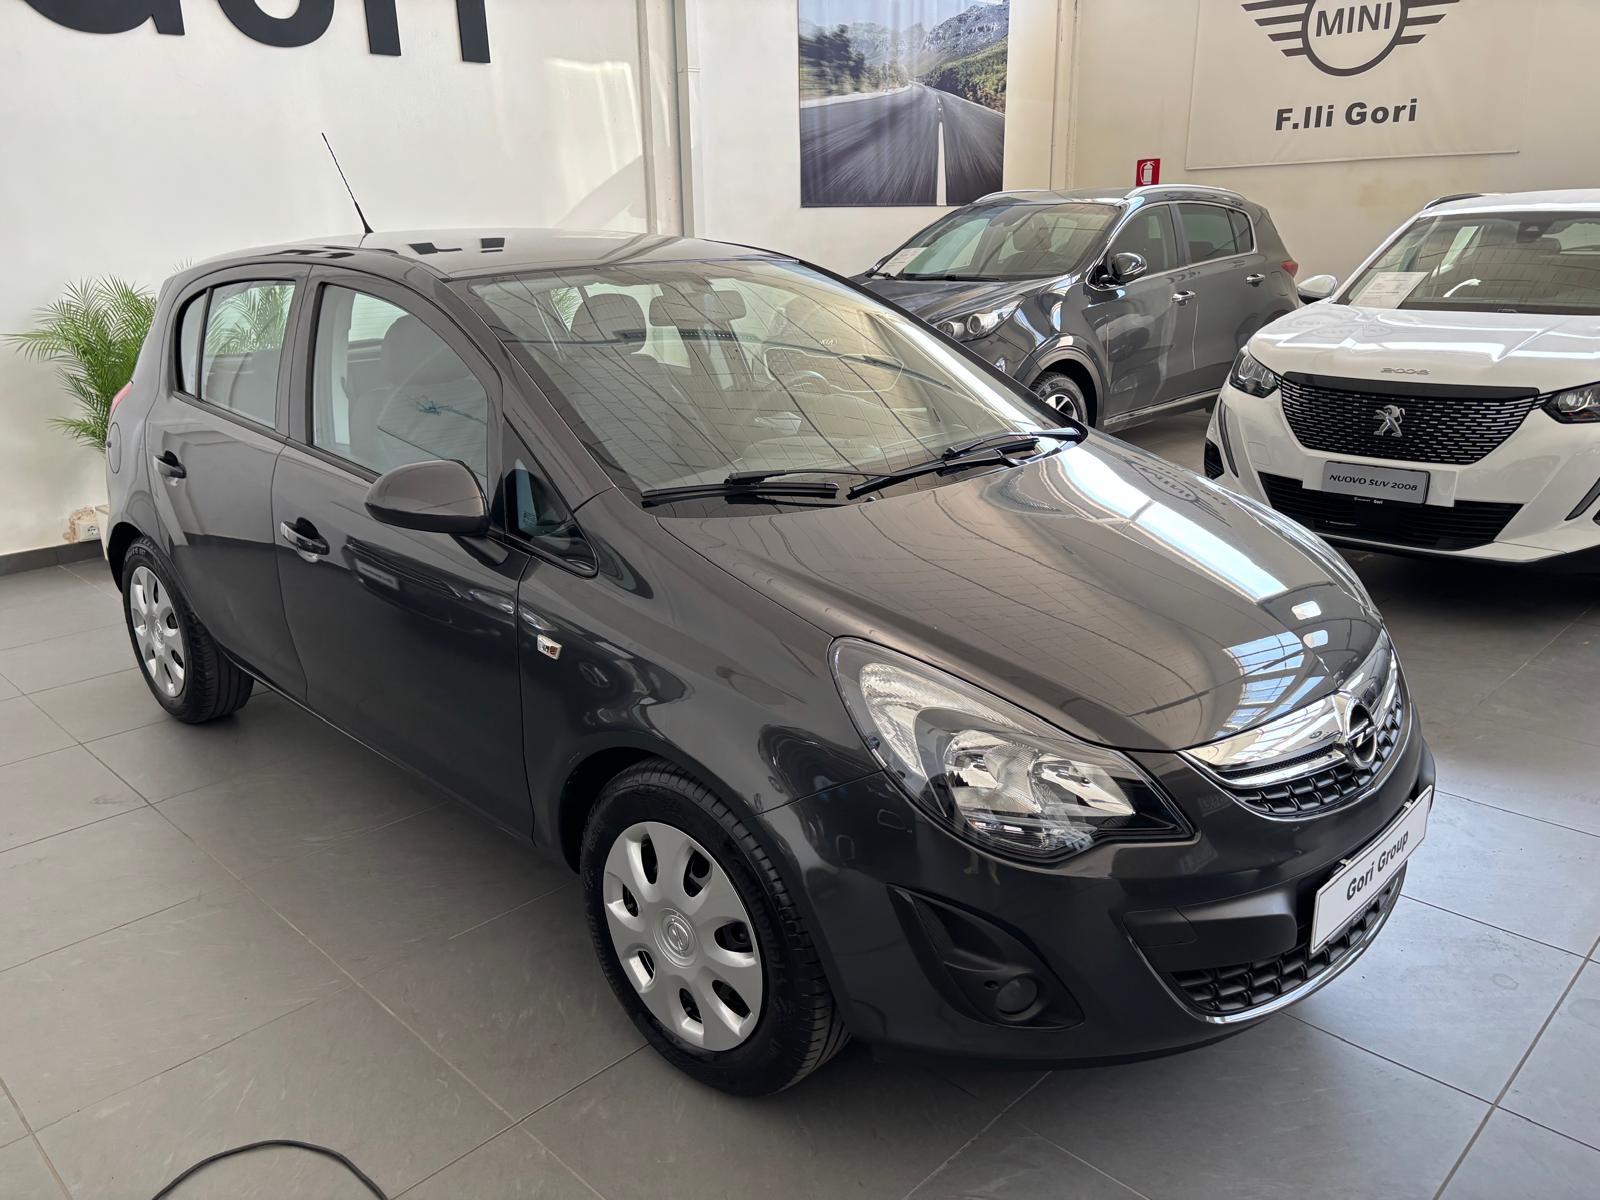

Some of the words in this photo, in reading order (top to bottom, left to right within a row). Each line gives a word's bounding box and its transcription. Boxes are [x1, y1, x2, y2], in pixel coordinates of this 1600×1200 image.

[1316, 2, 1392, 37] MINI
[1345, 98, 1417, 126] Gori
[1329, 474, 1367, 485] NUOVO
[1368, 479, 1390, 488] SUV
[1391, 482, 1418, 491] 2008
[1346, 861, 1375, 901] Gori
[1377, 830, 1409, 872] Group
